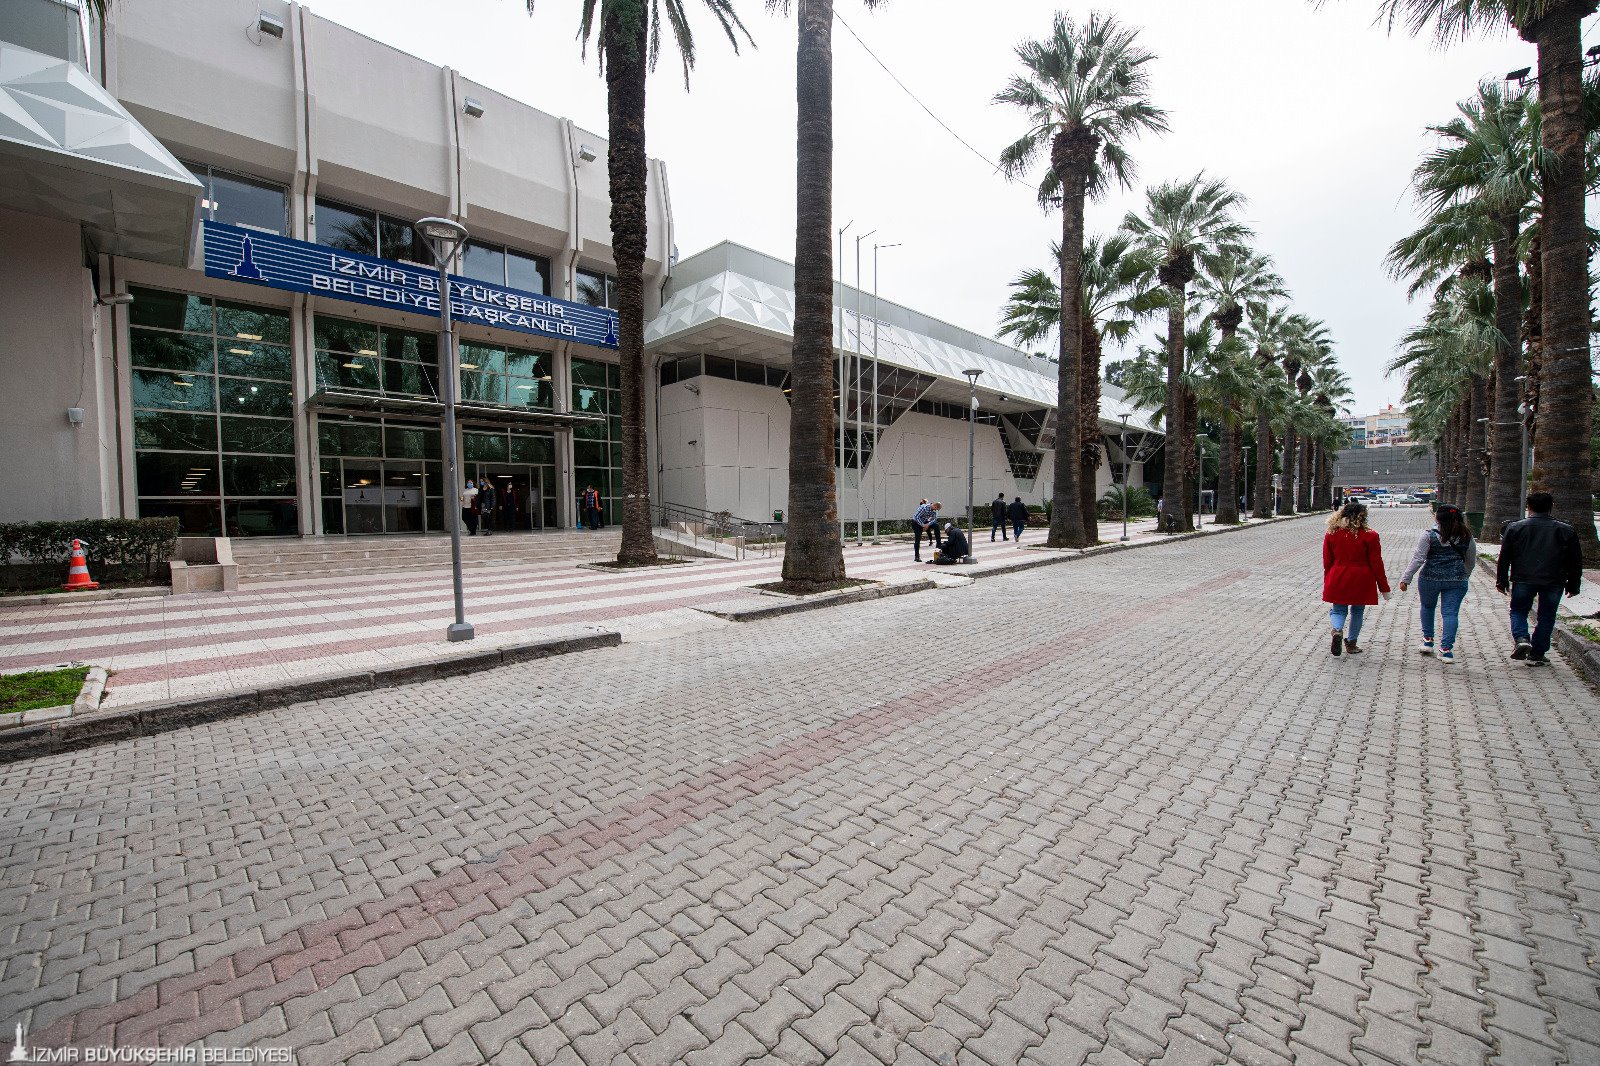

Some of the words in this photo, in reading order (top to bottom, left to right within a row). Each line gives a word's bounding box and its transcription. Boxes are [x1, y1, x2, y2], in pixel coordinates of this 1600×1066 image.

[331, 253, 406, 285] İZMİR
[312, 273, 442, 311] BELEDİYE
[451, 301, 579, 338] BAŞKANLIĞI
